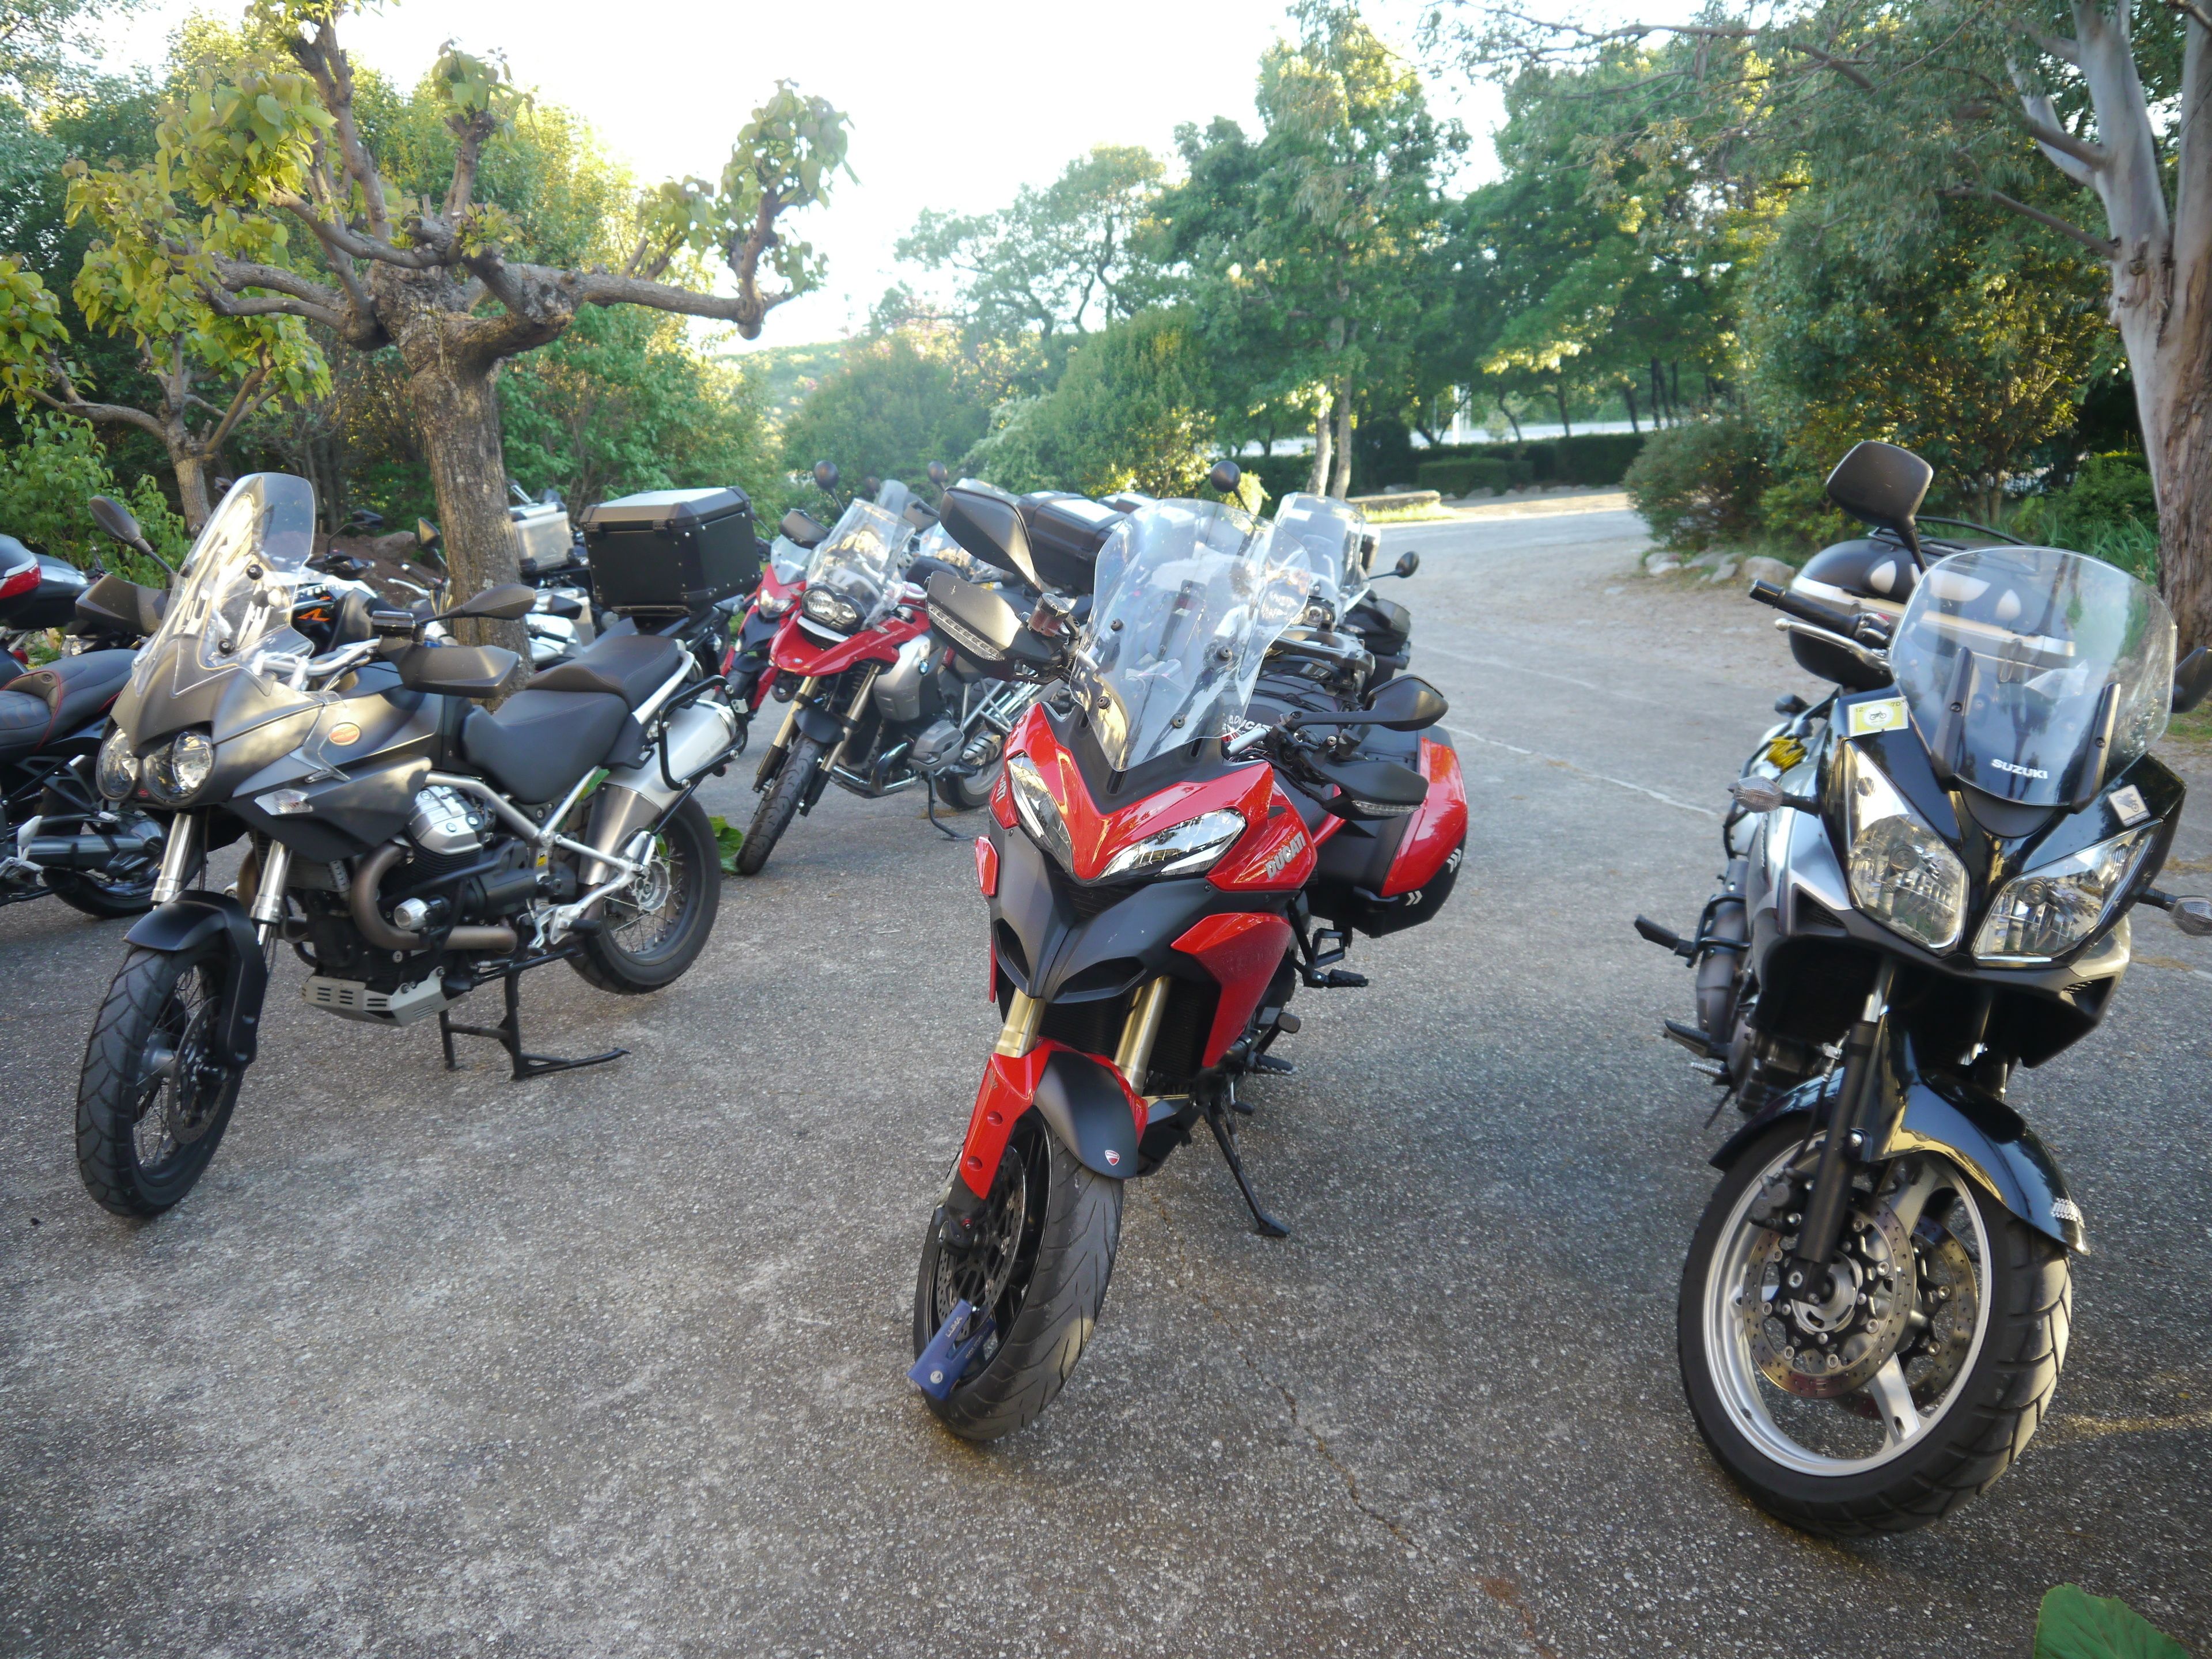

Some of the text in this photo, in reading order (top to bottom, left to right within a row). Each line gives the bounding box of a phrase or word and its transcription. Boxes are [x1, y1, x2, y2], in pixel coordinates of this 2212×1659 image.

[1991, 759, 2048, 779] SUZUKI
[1265, 831, 1307, 879] DUCATI
[945, 1317, 963, 1338] LUMA
